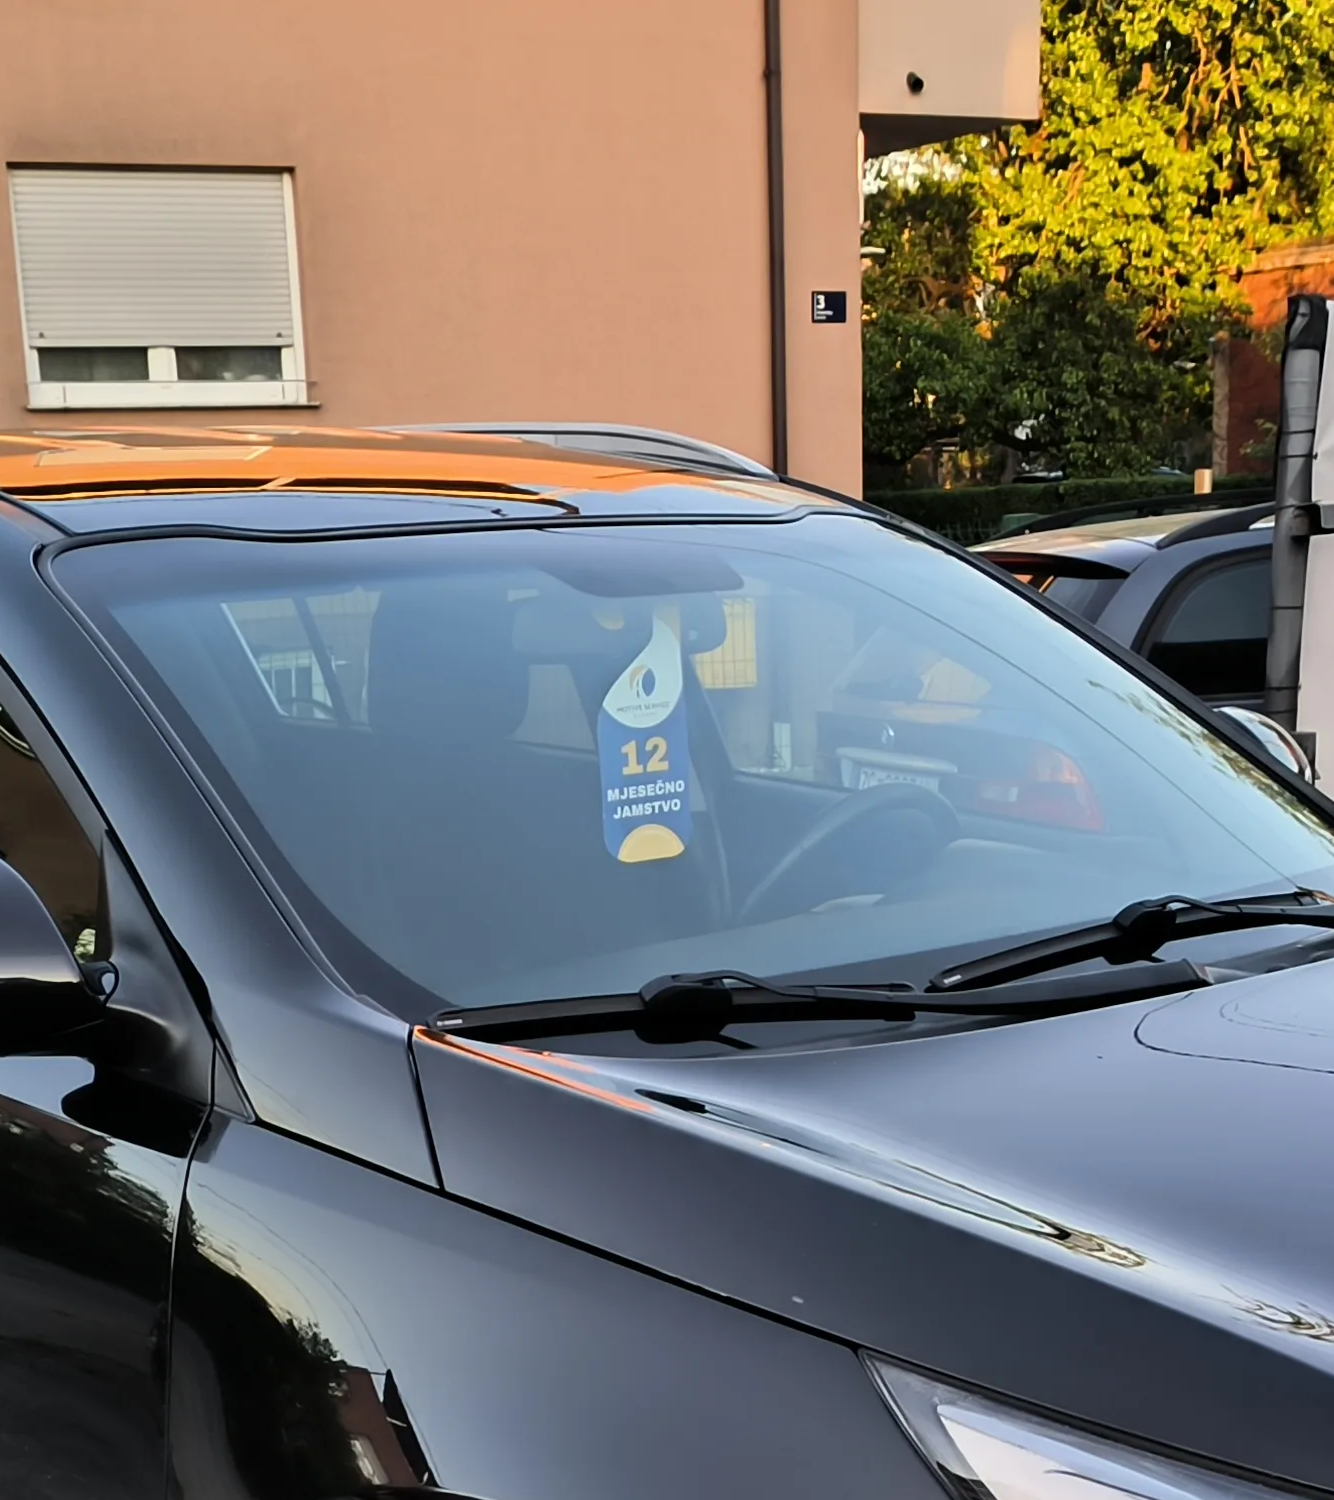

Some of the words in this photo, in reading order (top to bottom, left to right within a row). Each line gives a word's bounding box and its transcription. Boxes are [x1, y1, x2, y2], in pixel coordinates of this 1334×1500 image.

[621, 736, 669, 775] 12
[607, 779, 685, 802] MJESEČNO
[613, 798, 681, 819] JAMSTVO
